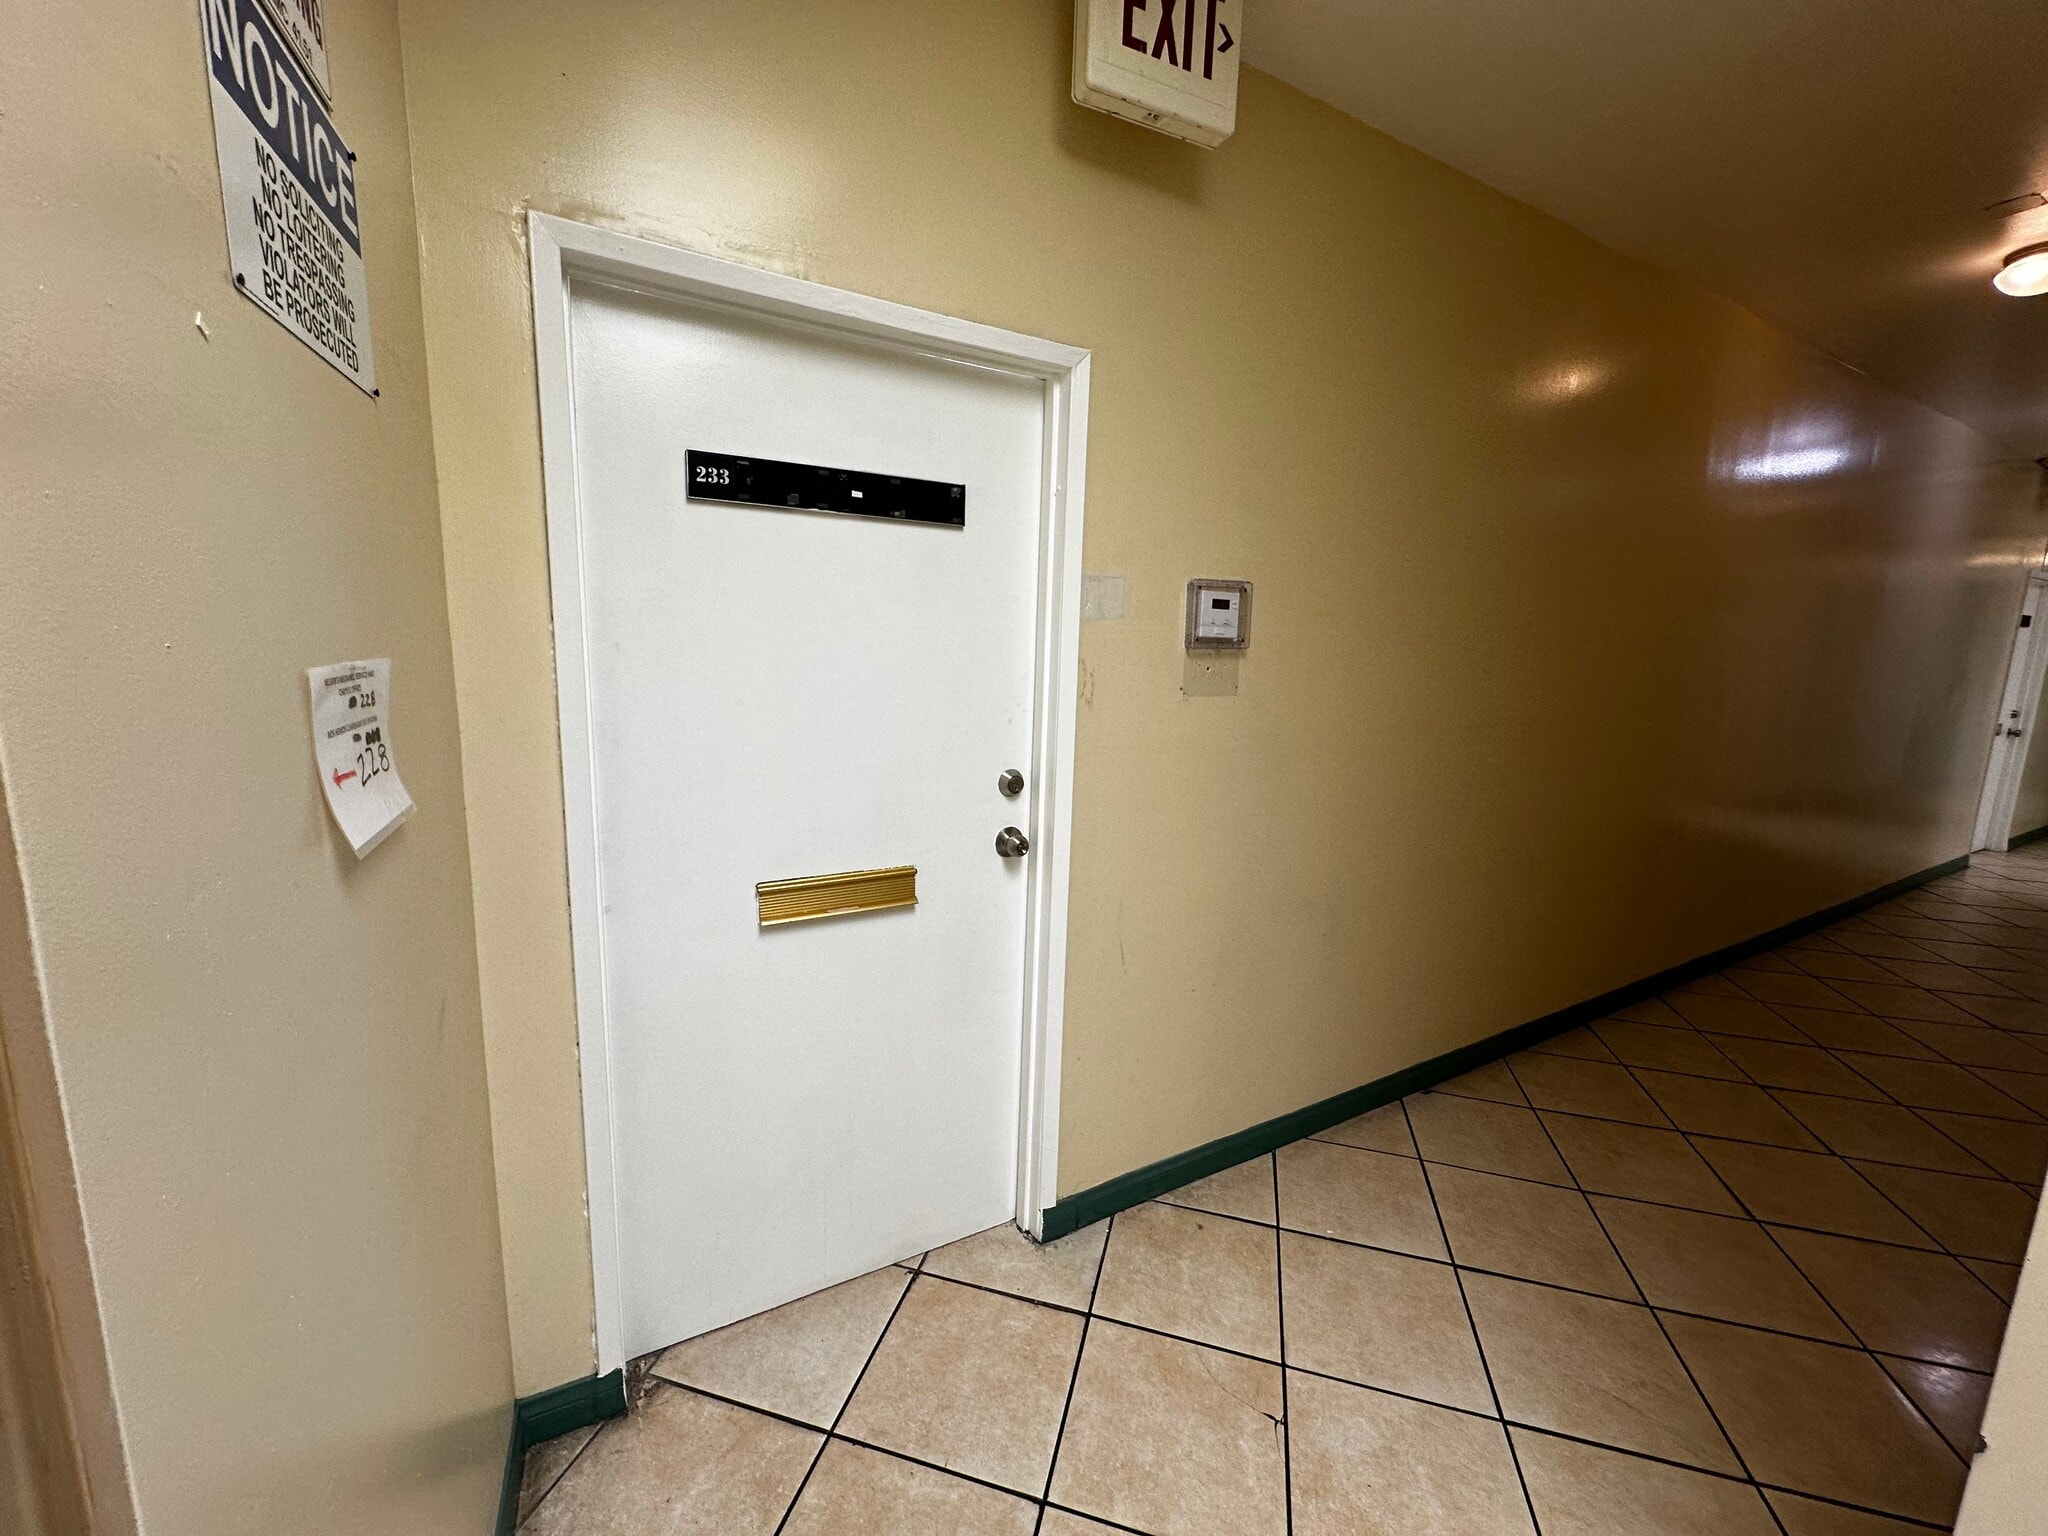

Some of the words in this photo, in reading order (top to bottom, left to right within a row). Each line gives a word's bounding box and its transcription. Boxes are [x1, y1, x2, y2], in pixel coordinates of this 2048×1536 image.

[1122, 0, 1225, 80] EXIT
[208, 0, 358, 238] NOTICE
[254, 137, 277, 184] NO
[280, 170, 343, 262] SOLICITING
[261, 175, 282, 220] NO
[285, 203, 345, 288] LOITERING
[252, 196, 275, 241] NO
[277, 223, 355, 322] TRESPASSING
[259, 234, 330, 324] VIOLATORS
[332, 306, 356, 348] WILL
[262, 269, 283, 309] BE
[286, 290, 359, 373] PROSECUTED
[696, 465, 730, 485] 233
[360, 691, 376, 708] 228
[357, 743, 390, 788] 228
